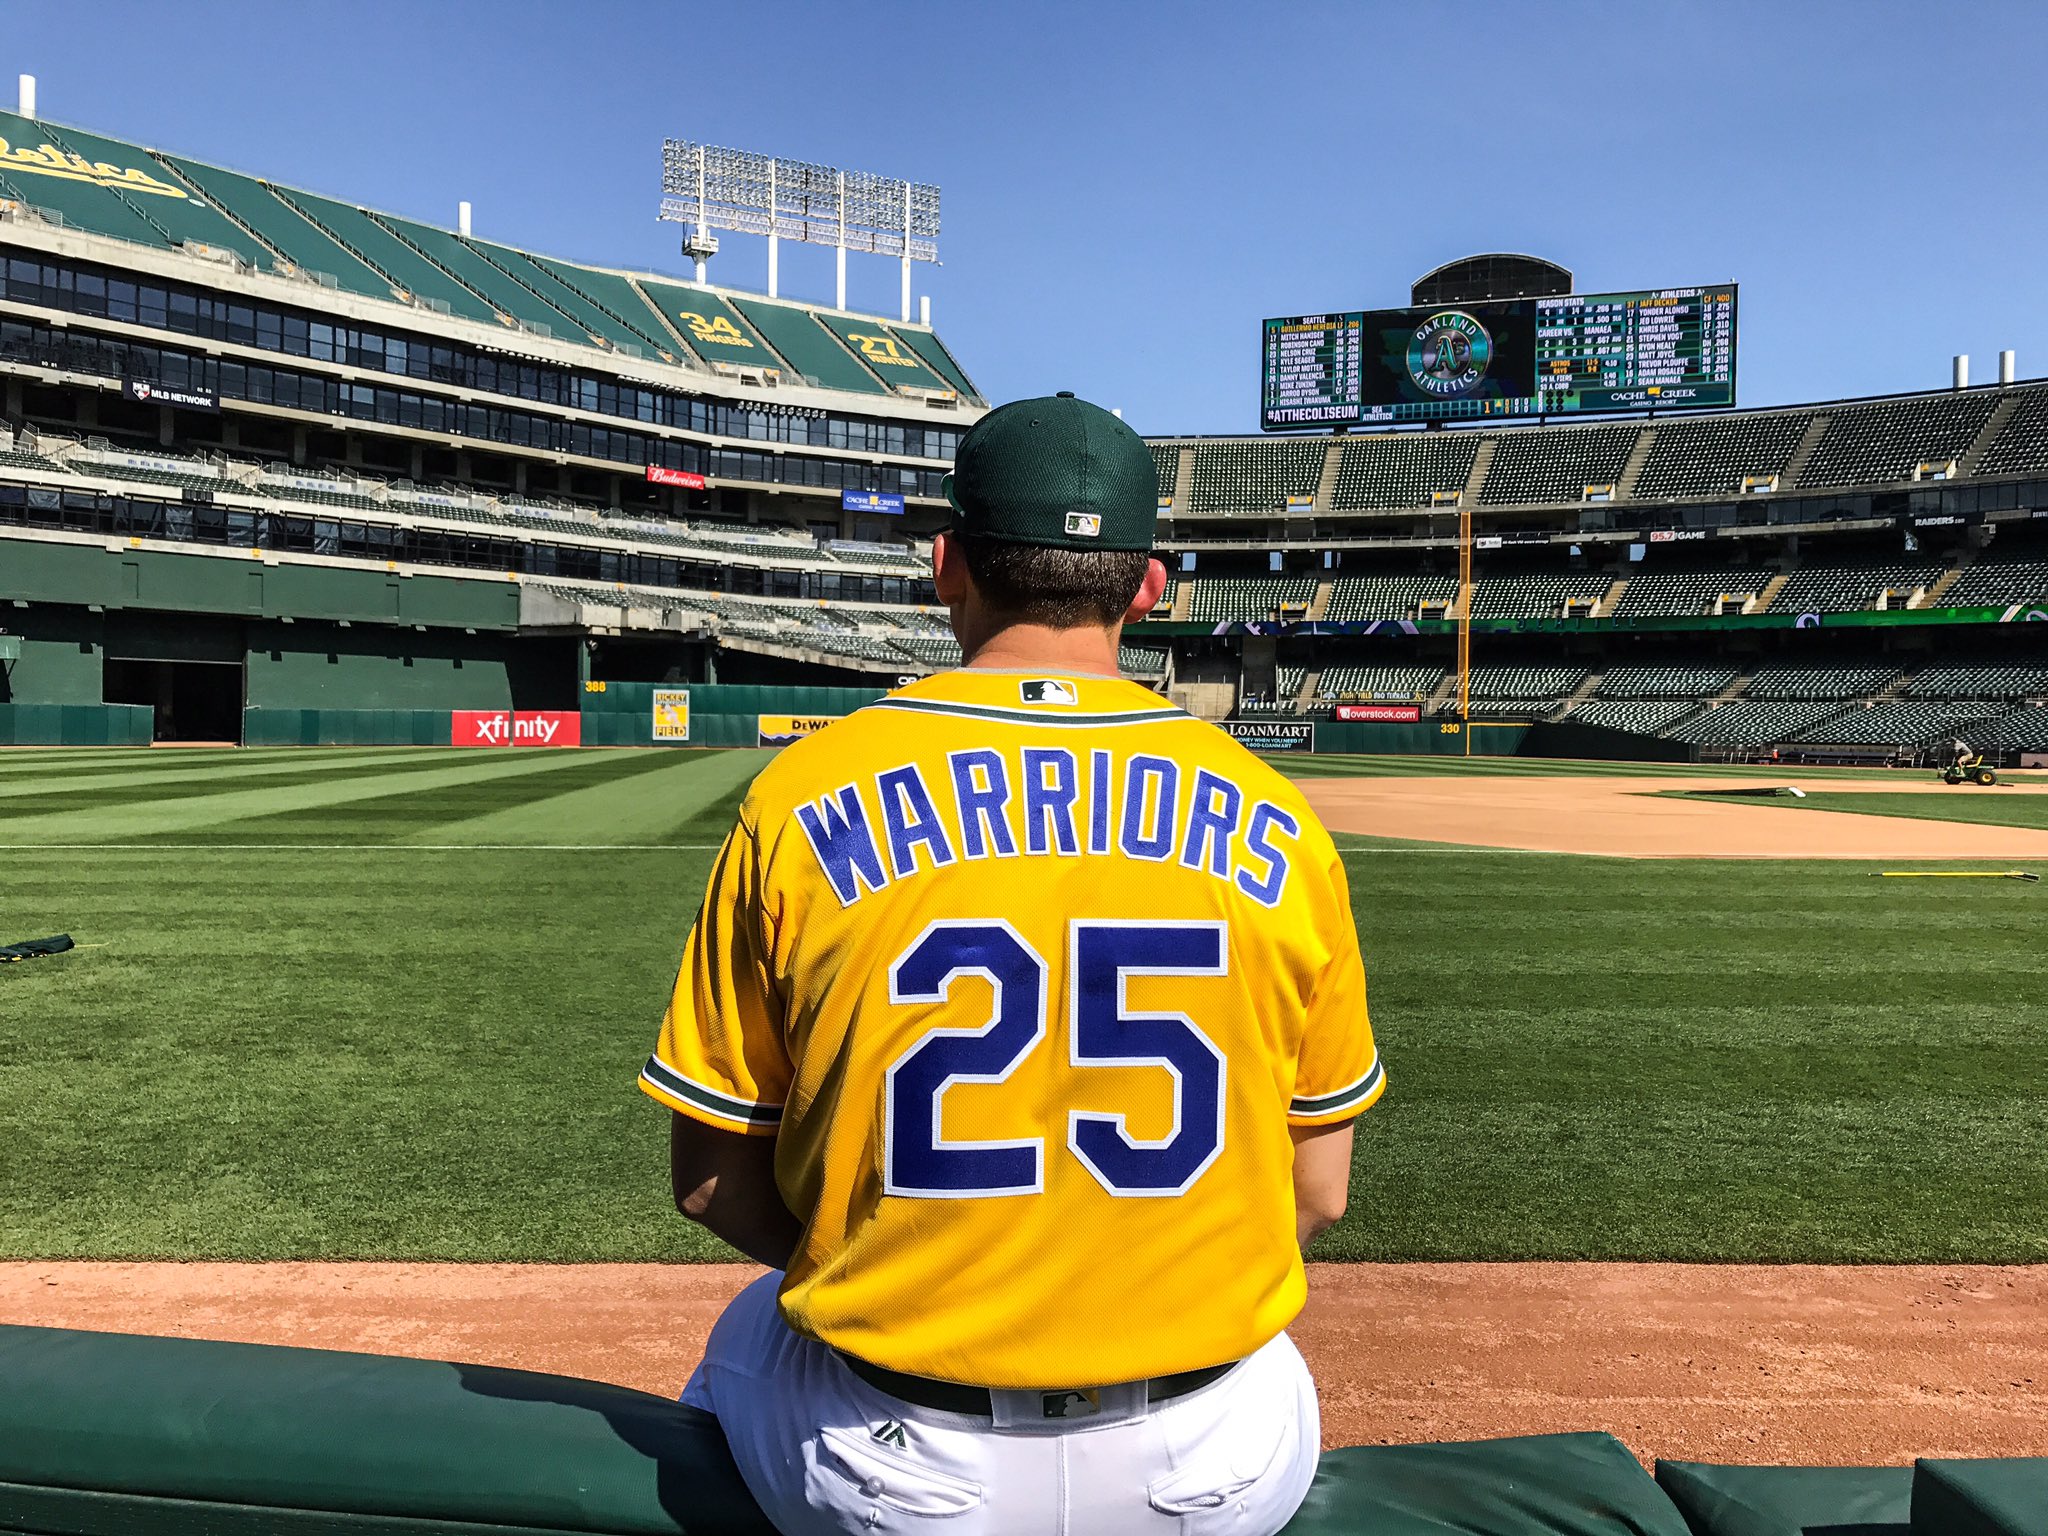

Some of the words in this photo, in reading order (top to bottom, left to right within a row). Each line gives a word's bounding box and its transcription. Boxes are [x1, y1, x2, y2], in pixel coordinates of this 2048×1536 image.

[1660, 289, 1695, 299] ATHLETICS
[1538, 300, 1563, 308] SEASON
[1564, 298, 1584, 306] STATS
[1639, 308, 1664, 316] YONDER
[1665, 305, 1689, 314] ALONSO
[1302, 316, 1326, 325] SEATTLE
[1651, 315, 1675, 323] LOWRIE
[680, 312, 741, 337] 34
[1416, 316, 1476, 340] OAKLAND
[1639, 325, 1658, 334] KHRIS
[1660, 324, 1679, 332] DAVIS
[1704, 321, 1711, 330] LF
[1538, 328, 1562, 338] CAREER
[1564, 328, 1574, 336] VS.
[1584, 325, 1612, 335] MANAEA
[694, 332, 754, 348] FINGERS
[1281, 333, 1299, 341] MITCH
[1639, 333, 1666, 342] STEPHEN
[1667, 332, 1683, 340] VOGT
[848, 334, 900, 357] 27
[1281, 340, 1308, 349] ROBINSON
[1656, 341, 1676, 349] HEALY
[1281, 349, 1300, 358] NELSON
[1302, 348, 1316, 356] CRUZ
[1638, 351, 1656, 359] MATT
[1657, 350, 1676, 358] JOYCE
[866, 354, 918, 368] HUNTER
[1281, 358, 1293, 366] KYLE
[1295, 356, 1316, 364] SEAGER
[1638, 360, 1662, 368] TREVOR
[1663, 358, 1689, 367] PLOUFFE
[1280, 366, 1300, 374] TAYLOR
[1301, 364, 1324, 372] MOTTER
[1638, 369, 1657, 377] ADAM
[1658, 367, 1685, 376] ROSALES
[1299, 372, 1326, 380] VALENCIA
[1414, 367, 1478, 392] ATHLETICS
[1638, 377, 1654, 386] SEAN
[1655, 376, 1681, 384] MANAEA
[1280, 382, 1294, 390] MIKE
[1336, 386, 1342, 395] CF
[151, 389, 170, 400] MLB
[170, 392, 212, 407] NETWORK
[1611, 392, 1646, 400] CACHE
[1661, 389, 1696, 398] CREEK
[1485, 401, 1490, 413] 1
[1268, 405, 1358, 422] #ATTHECOLISEUM
[1363, 412, 1393, 421] ATHLETICS
[650, 468, 702, 487] Budweiser
[1678, 531, 1705, 540] GAME
[585, 681, 606, 692] 388
[1350, 709, 1416, 719] overstock.com
[476, 716, 560, 743] xfinity
[656, 727, 686, 737] FIELD
[1440, 724, 1460, 734] 330
[794, 746, 1300, 908] WARRIORS
[883, 918, 1228, 1198] 25
